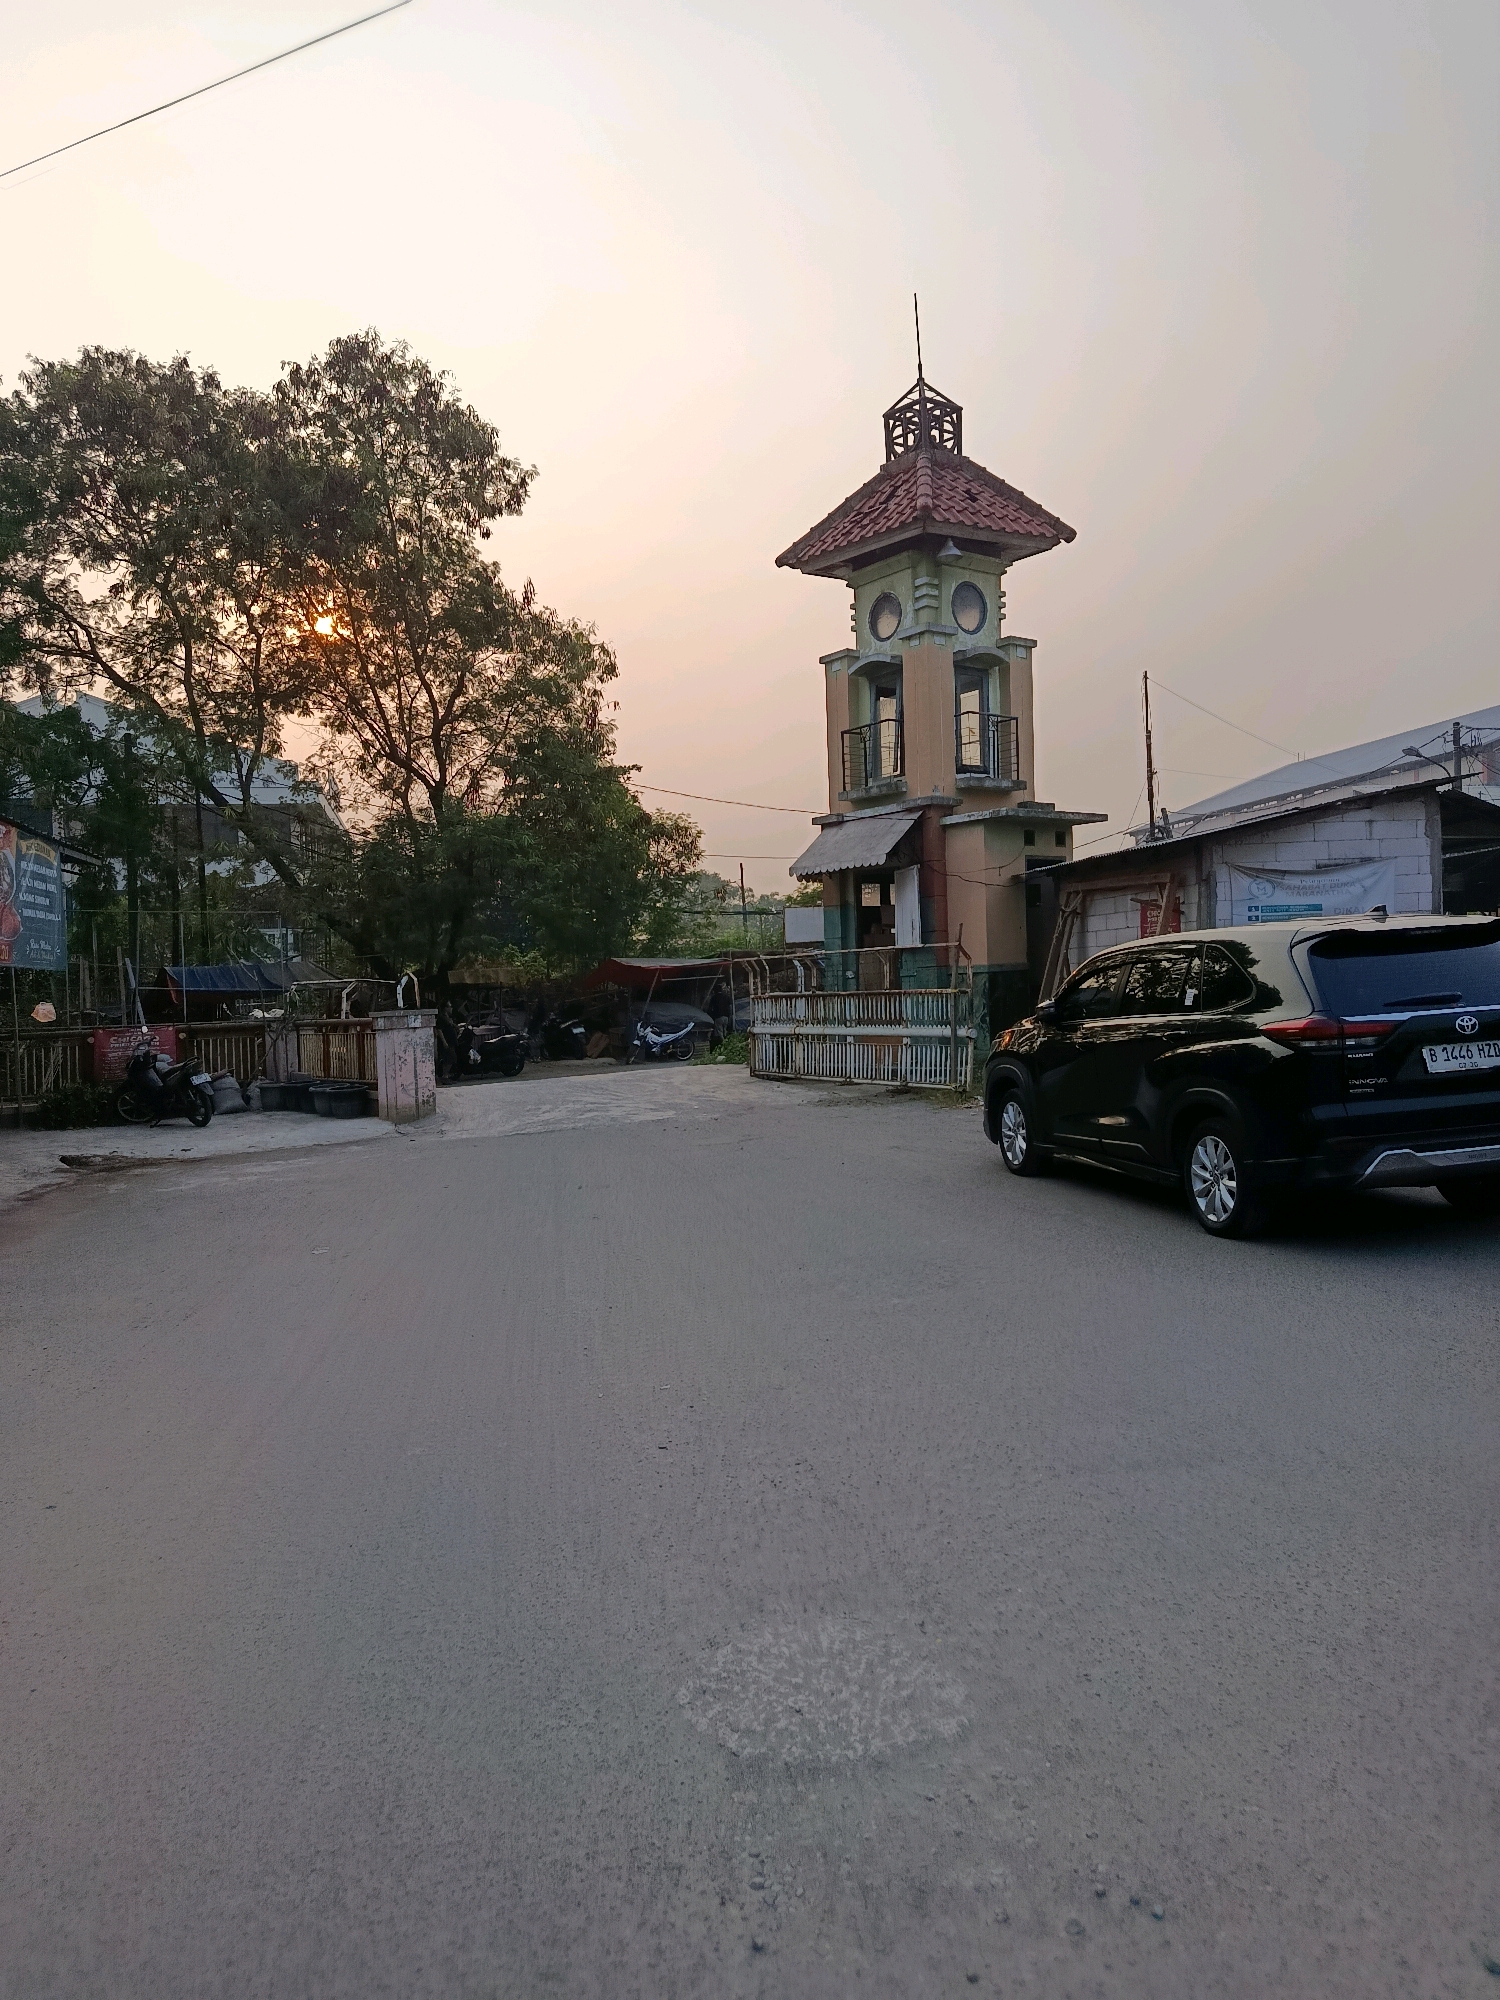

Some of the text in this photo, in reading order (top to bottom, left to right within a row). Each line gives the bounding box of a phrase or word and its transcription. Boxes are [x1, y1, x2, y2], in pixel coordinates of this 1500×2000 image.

[1280, 881, 1356, 891] SAHABAT DUKA
[1285, 889, 1353, 897] MARANATHA
[1428, 1043, 1500, 1062] B 1446 HZD
